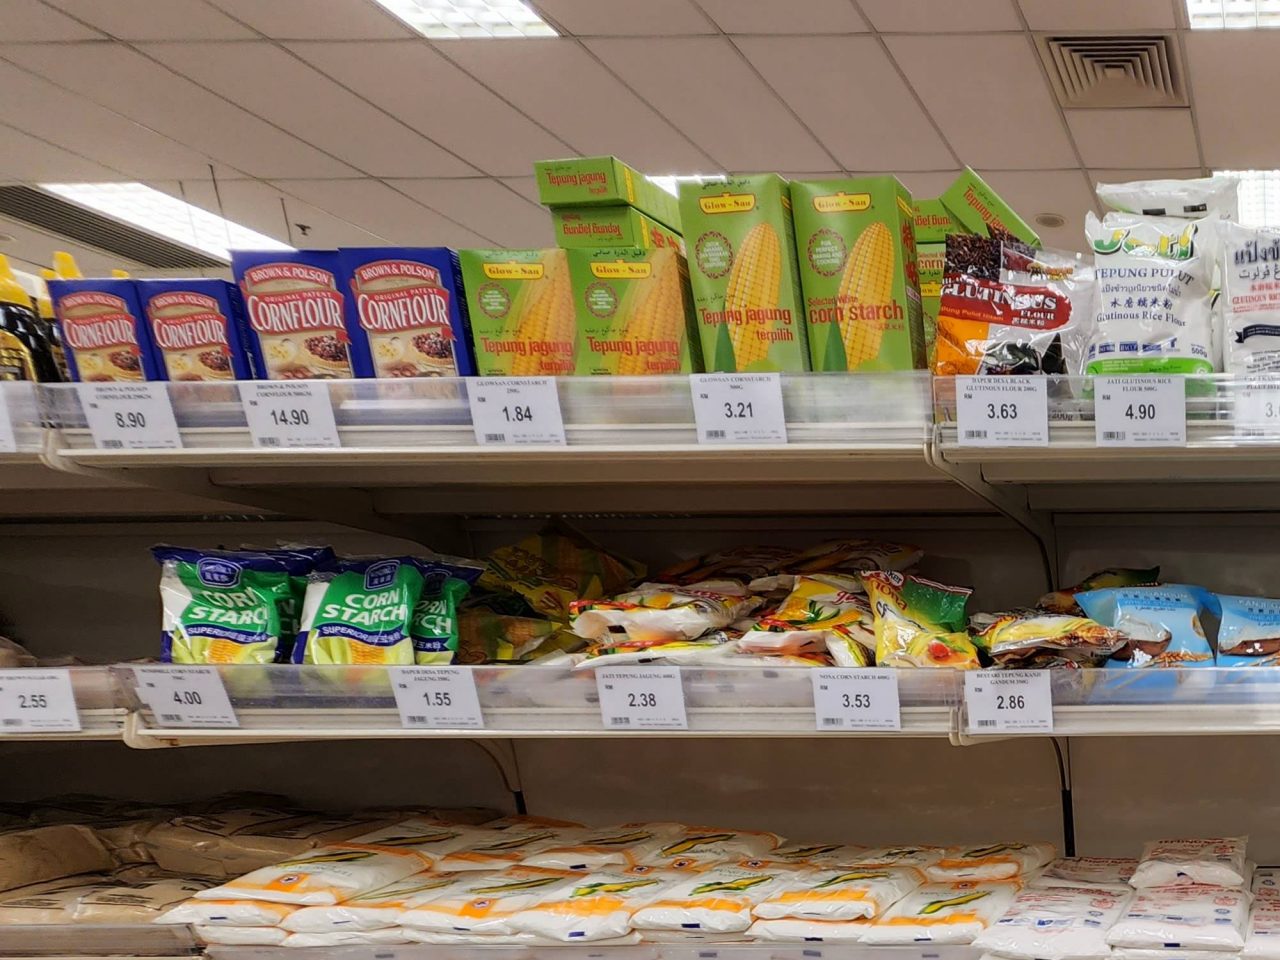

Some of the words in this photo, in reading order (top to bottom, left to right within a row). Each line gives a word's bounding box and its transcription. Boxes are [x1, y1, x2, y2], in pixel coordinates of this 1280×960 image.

[546, 172, 578, 186] Tepung
[578, 172, 606, 184] jagung
[963, 185, 993, 222] Tepung
[251, 267, 283, 282] BROWN
[293, 269, 329, 283] POLSON
[362, 264, 392, 279] BROWN
[400, 264, 435, 279] POLSON
[1095, 268, 1148, 280] TEPUNG
[1151, 269, 1194, 286] PULUT
[264, 293, 300, 302] ORIGINAL
[303, 291, 332, 299] PATENT
[373, 291, 408, 301] ORIGINAL
[409, 288, 438, 297] PATENT
[248, 295, 345, 332] CORNFLOUR
[358, 294, 450, 330] CORNFLOUR
[699, 308, 743, 325] Tepung
[745, 308, 791, 326] jagung
[809, 305, 844, 325] corn
[849, 300, 904, 321] starch
[1020, 310, 1055, 320] FLOUR
[1096, 312, 1140, 322] Glutinous
[1142, 311, 1163, 321] Rice
[1165, 313, 1186, 327] Flour
[63, 318, 138, 348] CORNFLOUR
[153, 318, 228, 348] CORNFLOUR
[756, 328, 793, 344] terpilih
[481, 337, 526, 356] Tepung
[528, 338, 572, 358] jagung
[587, 336, 632, 356] Tepung
[635, 337, 681, 358] jagung
[271, 409, 309, 425] 14.90
[502, 406, 533, 422] 1.84
[724, 402, 753, 418] 3.21
[987, 403, 1018, 420] 3.63
[1125, 403, 1156, 420] 4.90
[115, 412, 145, 428] 8.90
[345, 588, 400, 609] CORN
[322, 604, 408, 626] STARCH
[322, 626, 369, 641] SUPERIOR
[18, 694, 47, 709] 2.55
[173, 690, 202, 706] 4.00
[423, 693, 451, 706] 1.55
[627, 693, 657, 708] 2.38
[842, 693, 870, 708] 3.53
[997, 695, 1025, 710] 2.86
